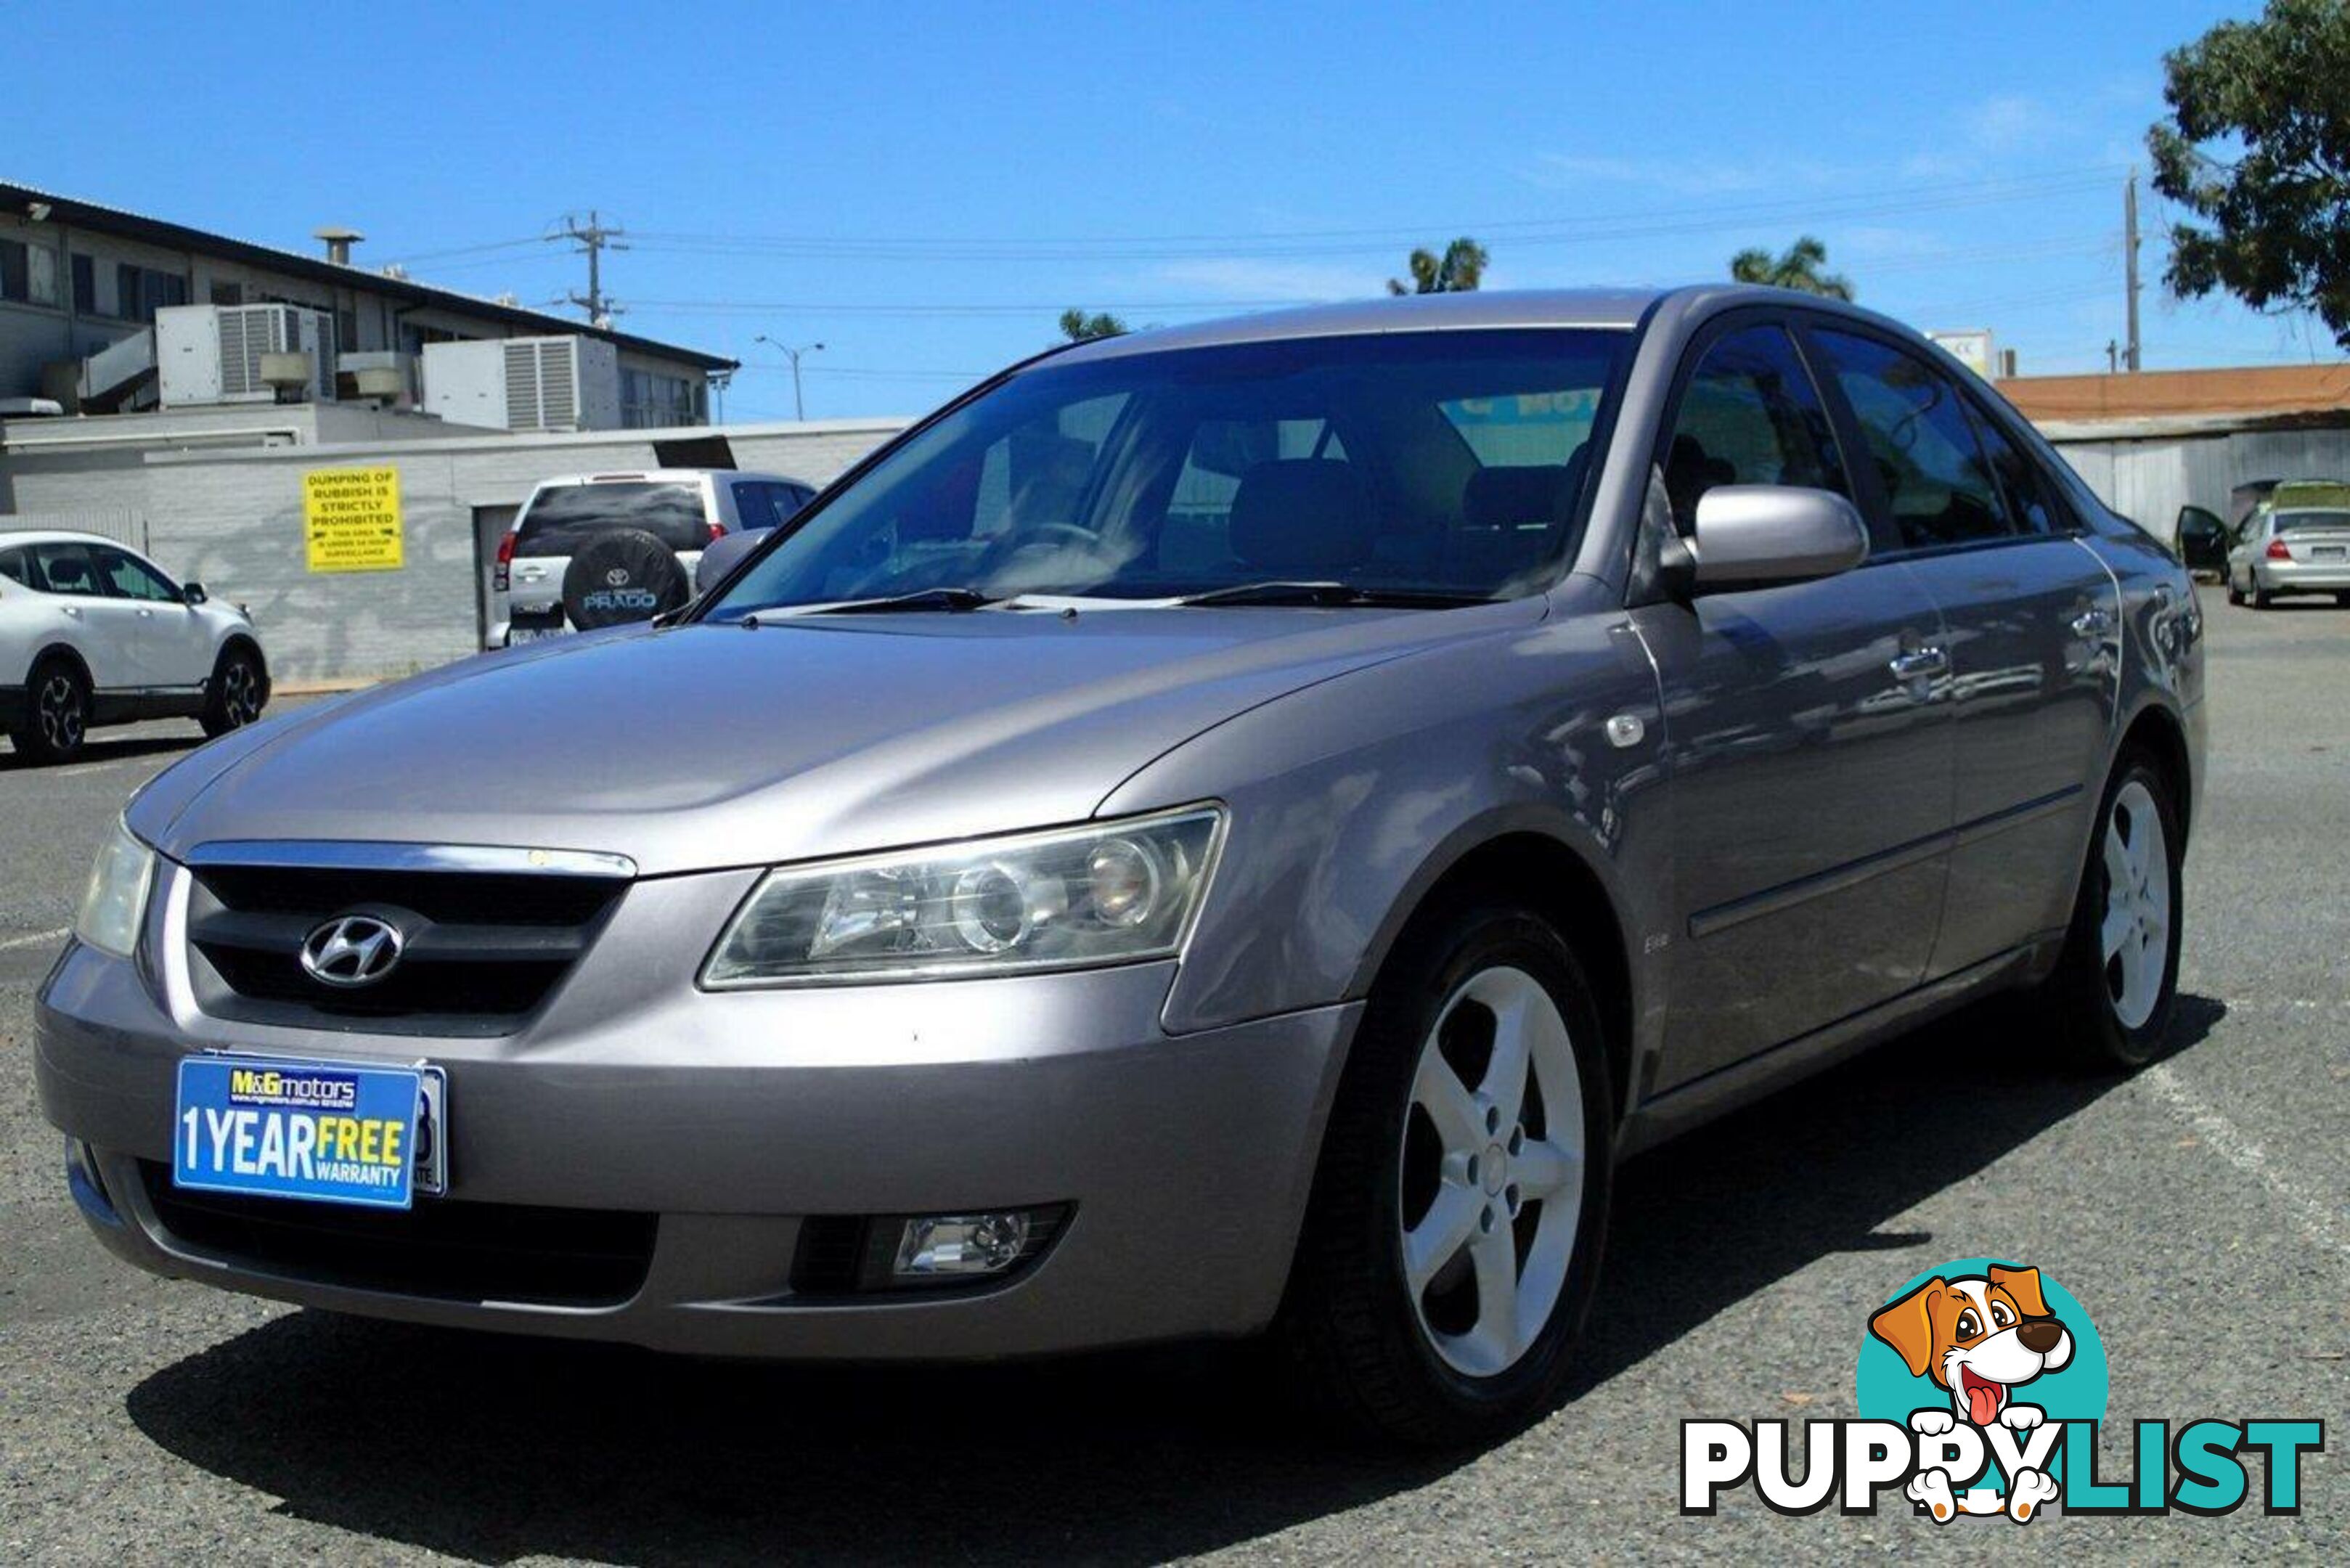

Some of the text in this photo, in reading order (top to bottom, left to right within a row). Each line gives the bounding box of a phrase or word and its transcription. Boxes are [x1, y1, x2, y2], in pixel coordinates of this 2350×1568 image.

[308, 473, 393, 486] DUMPING OF
[314, 486, 388, 499] RUBBISH IS
[321, 501, 383, 512] STRICTLY
[311, 514, 393, 526] PROHIBITED
[583, 593, 656, 609] PRADO
[182, 1106, 200, 1170] 1
[205, 1108, 316, 1180] YEAR
[317, 1116, 405, 1166] FREE
[317, 1163, 400, 1187] WARRANTY
